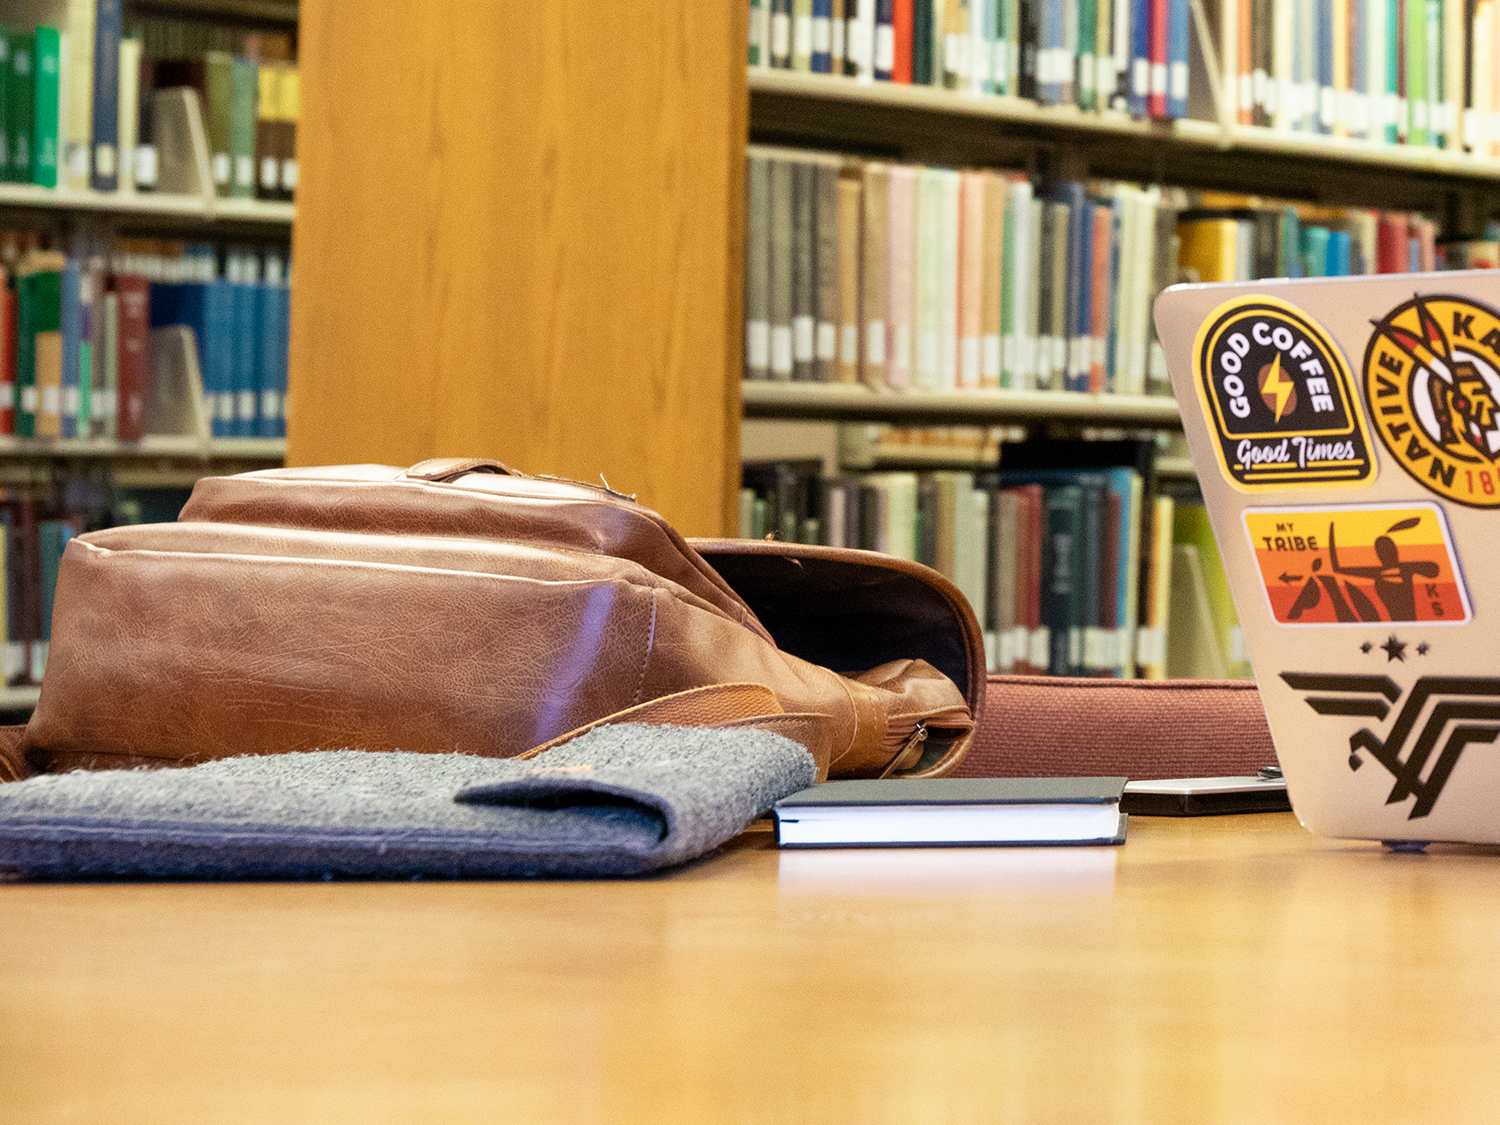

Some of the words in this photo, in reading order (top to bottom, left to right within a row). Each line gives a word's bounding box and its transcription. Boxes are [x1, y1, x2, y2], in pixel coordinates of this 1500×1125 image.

[1220, 331, 1251, 418] GOOD
[1252, 322, 1335, 414] COFFEE
[1377, 350, 1457, 488] NATIVE
[1236, 438, 1290, 471] Good
[1291, 436, 1356, 468] Times
[1262, 536, 1318, 552] TRIBE
[1276, 522, 1295, 532] MY
